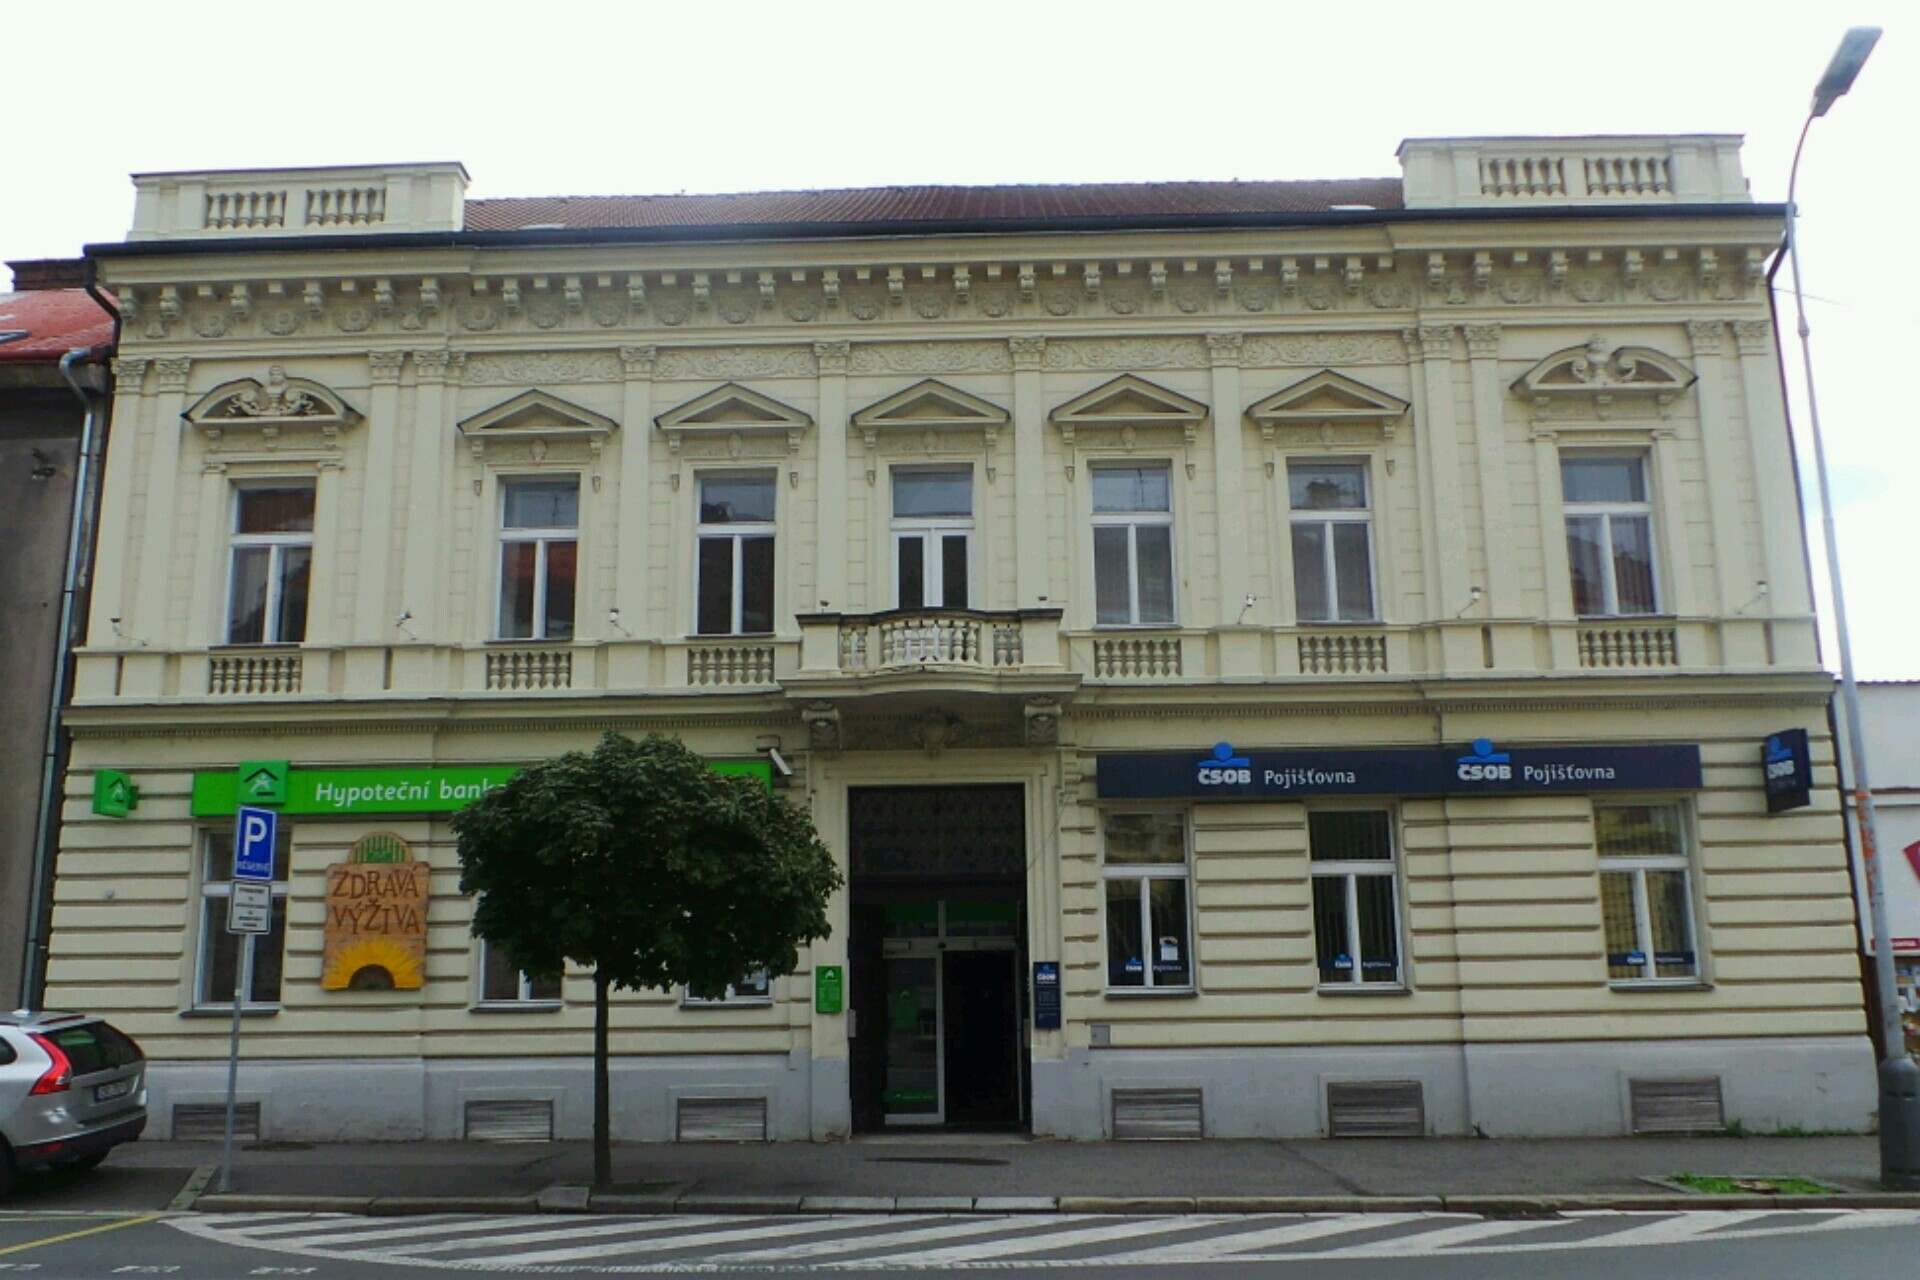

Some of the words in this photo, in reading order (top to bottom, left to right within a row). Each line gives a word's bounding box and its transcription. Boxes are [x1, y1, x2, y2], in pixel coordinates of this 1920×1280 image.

[1198, 767, 1251, 785] ČSOB
[1264, 767, 1356, 789] Pojišťovna
[1457, 763, 1512, 781] ČSOB
[1523, 763, 1615, 785] Pojišťovna
[315, 780, 432, 807] Hypoteční
[243, 815, 268, 856] P
[332, 865, 420, 899] ZDRAVÁ
[332, 898, 420, 935] VÝŽIVA
